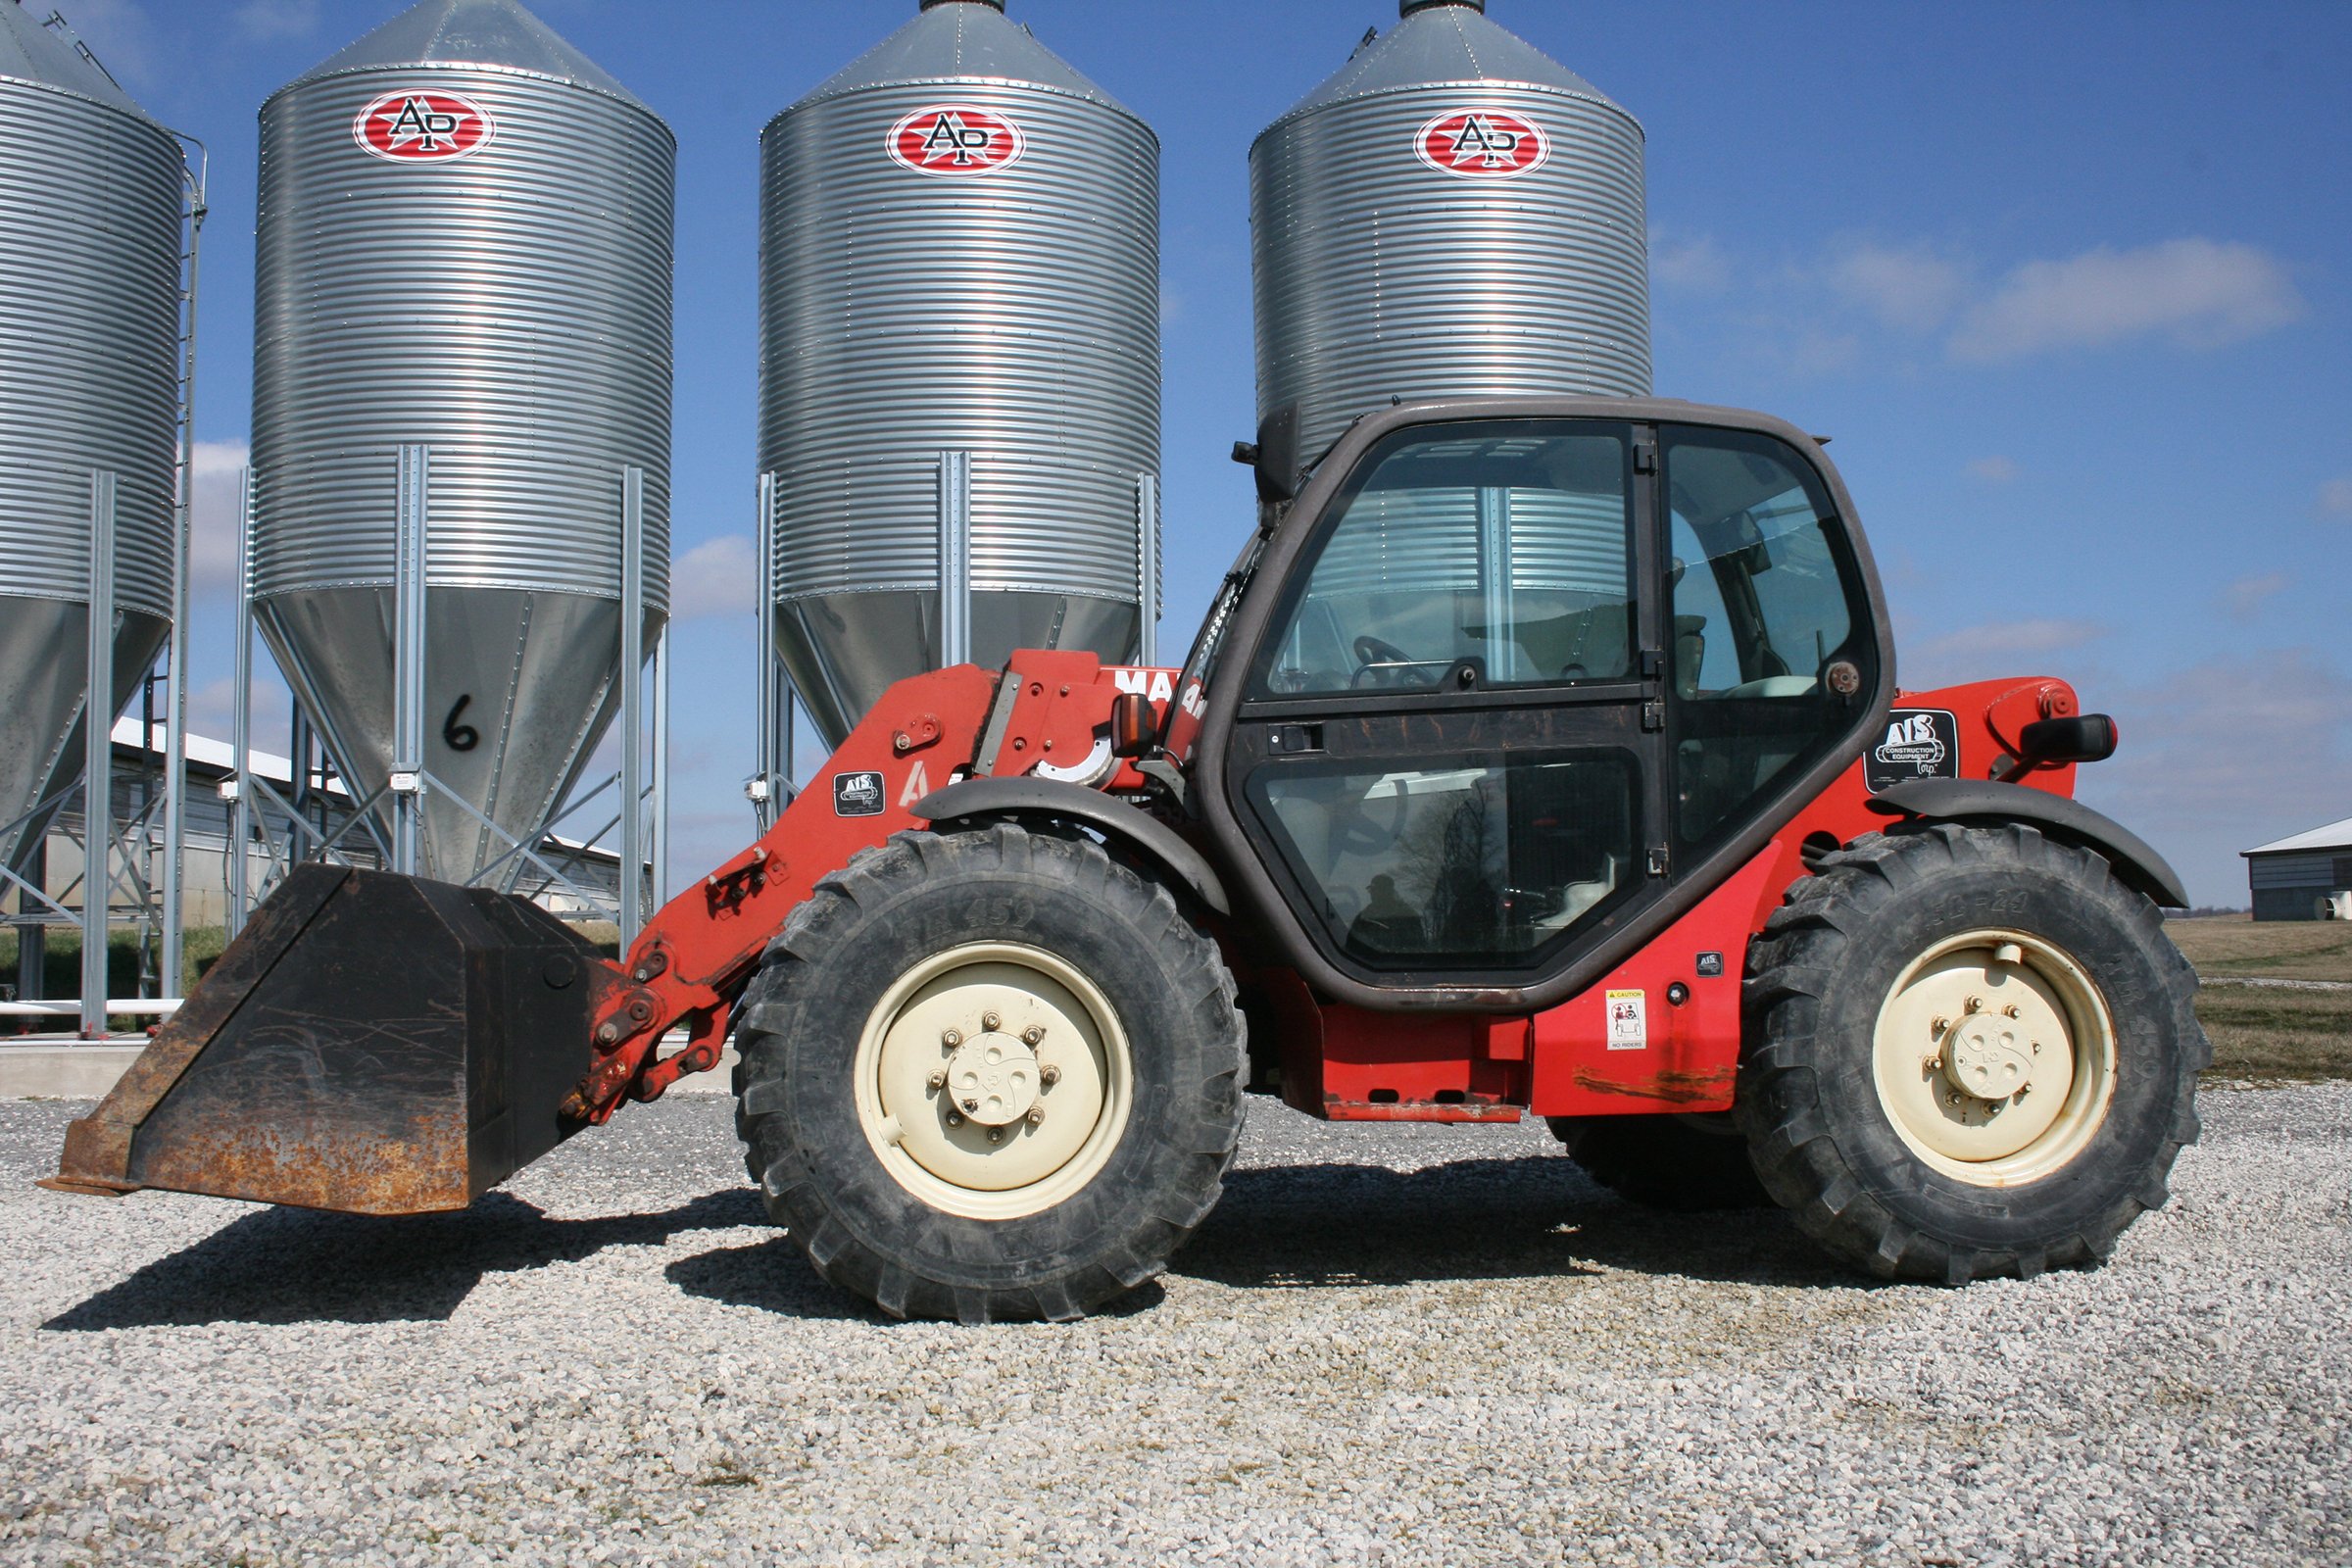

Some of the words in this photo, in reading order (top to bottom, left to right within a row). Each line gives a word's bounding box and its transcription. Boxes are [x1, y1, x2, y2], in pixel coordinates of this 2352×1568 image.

[389, 98, 458, 149] AP
[923, 114, 989, 164] AP
[1452, 116, 1516, 166] AP
[442, 694, 479, 752] 6
[1886, 713, 1936, 745] AIS
[846, 774, 873, 792] AIS
[963, 898, 1035, 929] 459
